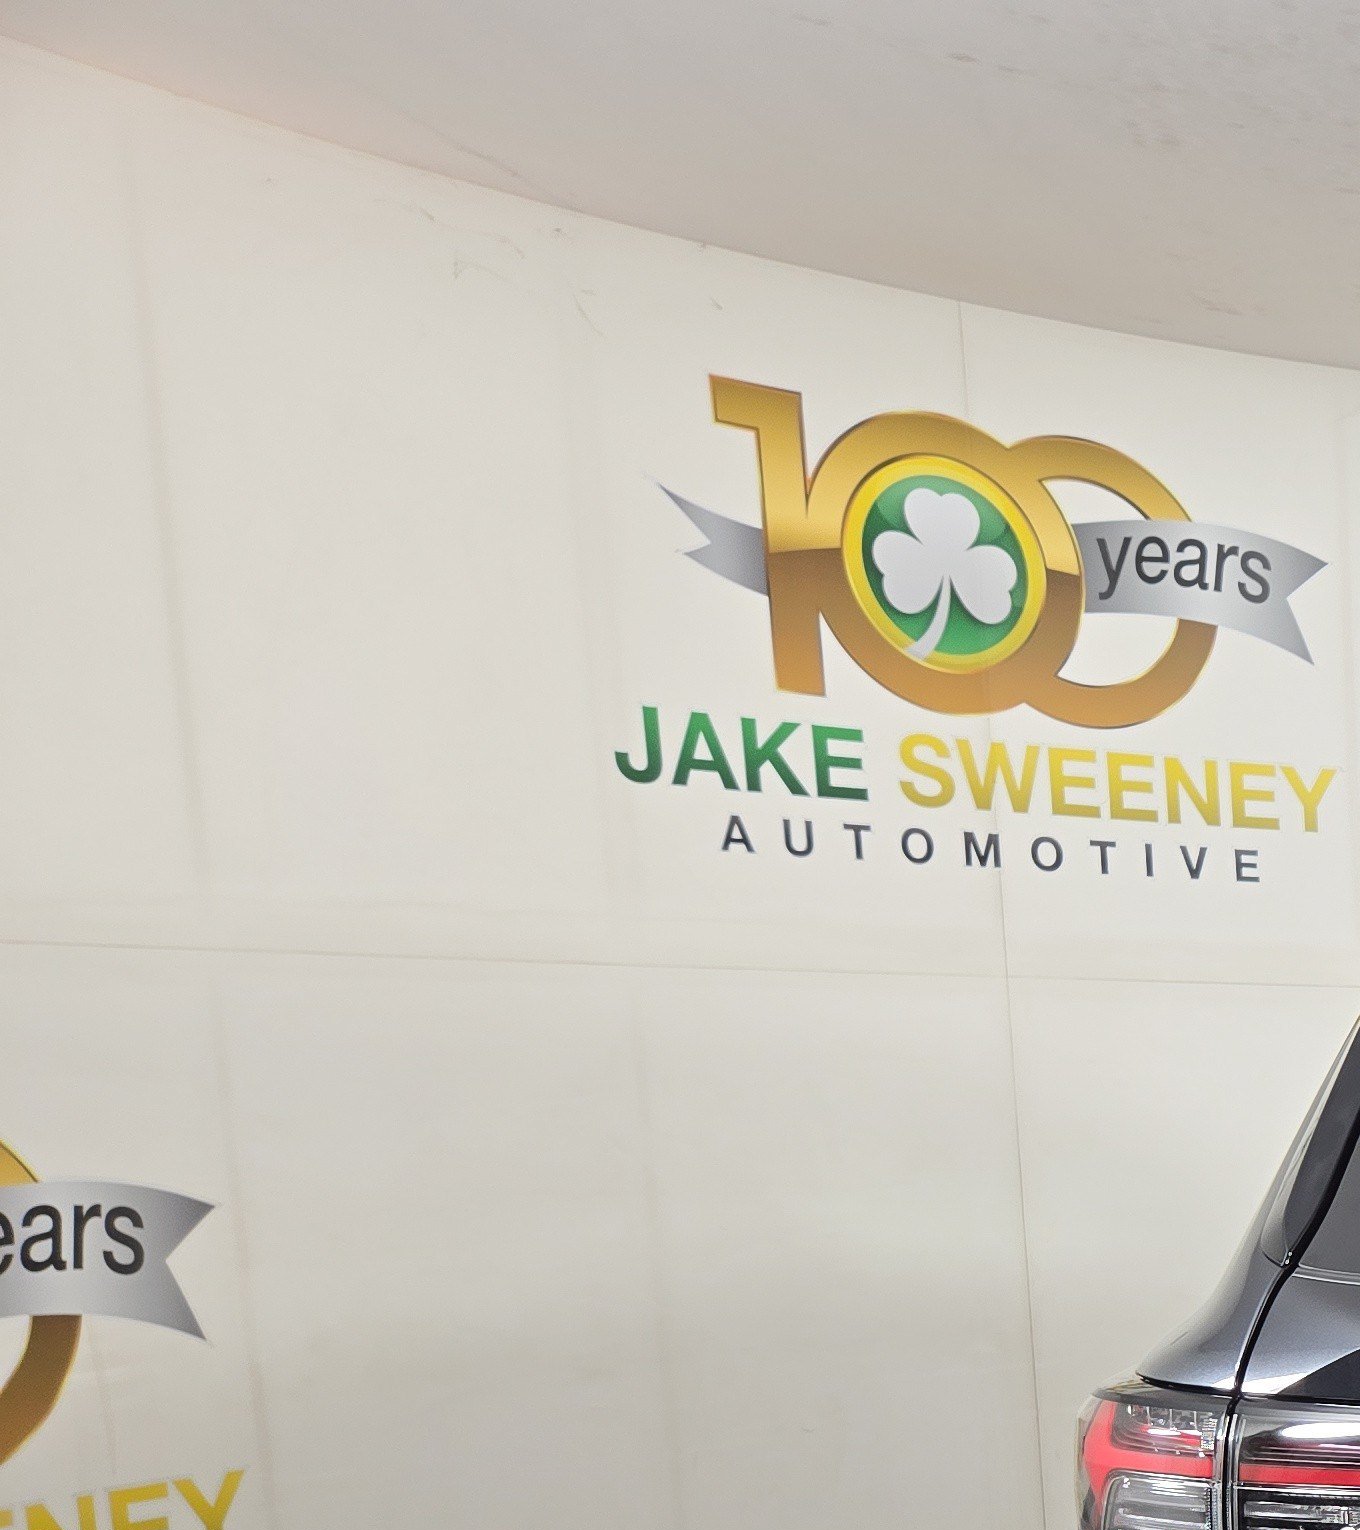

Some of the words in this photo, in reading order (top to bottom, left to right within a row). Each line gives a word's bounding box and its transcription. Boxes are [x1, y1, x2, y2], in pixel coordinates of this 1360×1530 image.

[709, 373, 1217, 728] 100
[1096, 527, 1272, 603] years
[615, 705, 869, 801] JAKE
[899, 732, 1337, 833] SWEENEY
[721, 814, 1261, 883] AUTOMOTIVE
